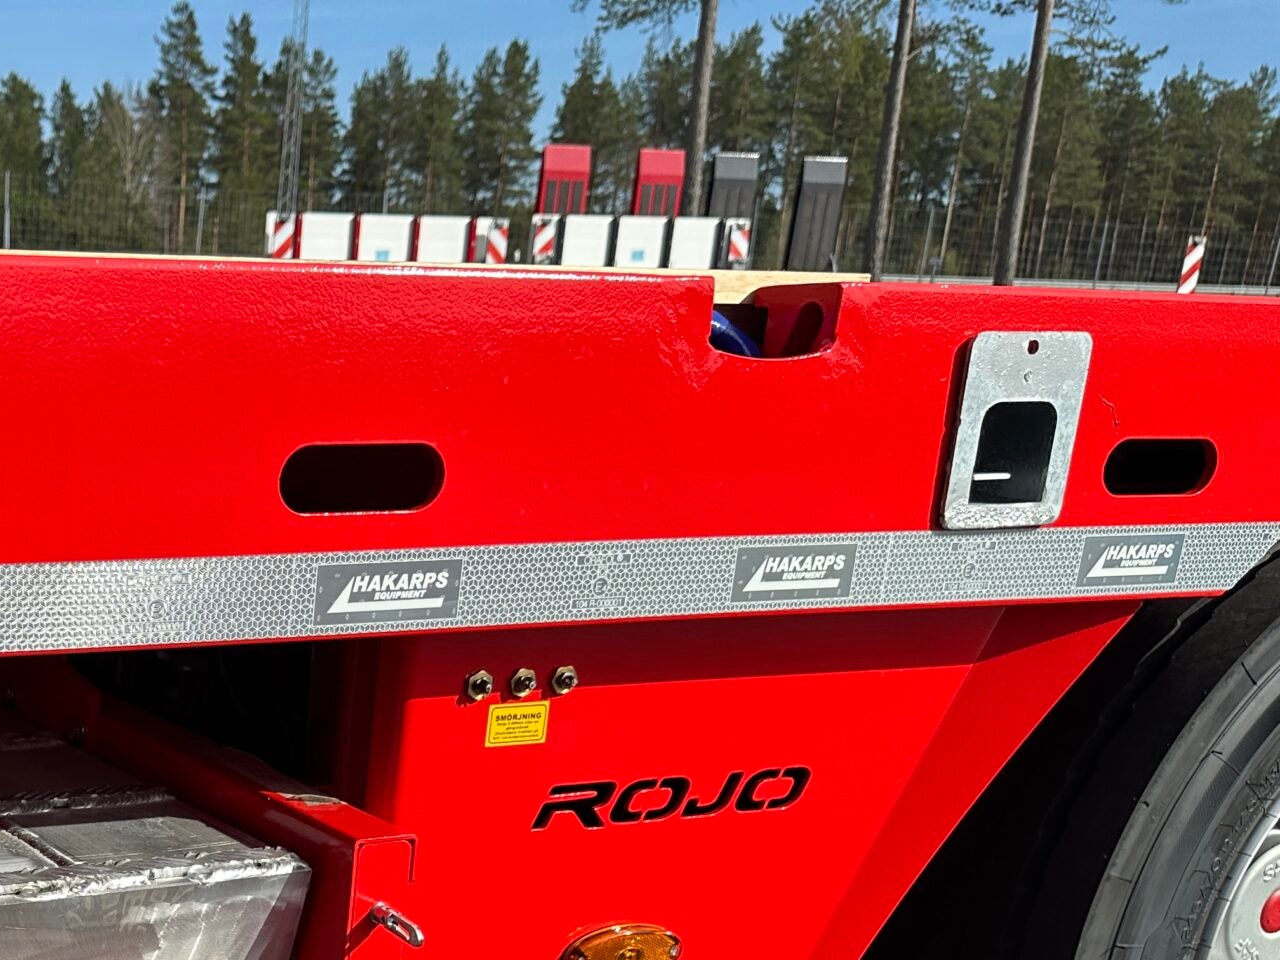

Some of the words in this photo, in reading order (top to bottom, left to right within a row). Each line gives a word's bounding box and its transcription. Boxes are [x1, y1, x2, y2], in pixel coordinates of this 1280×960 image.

[1106, 543, 1175, 560] HAKARPS
[765, 554, 846, 573] HAKARPS
[352, 571, 449, 593] HAKARPS
[782, 570, 827, 580] EQUIPMENT
[374, 589, 427, 600] EQUIPMENT
[531, 766, 812, 832] ROJO
